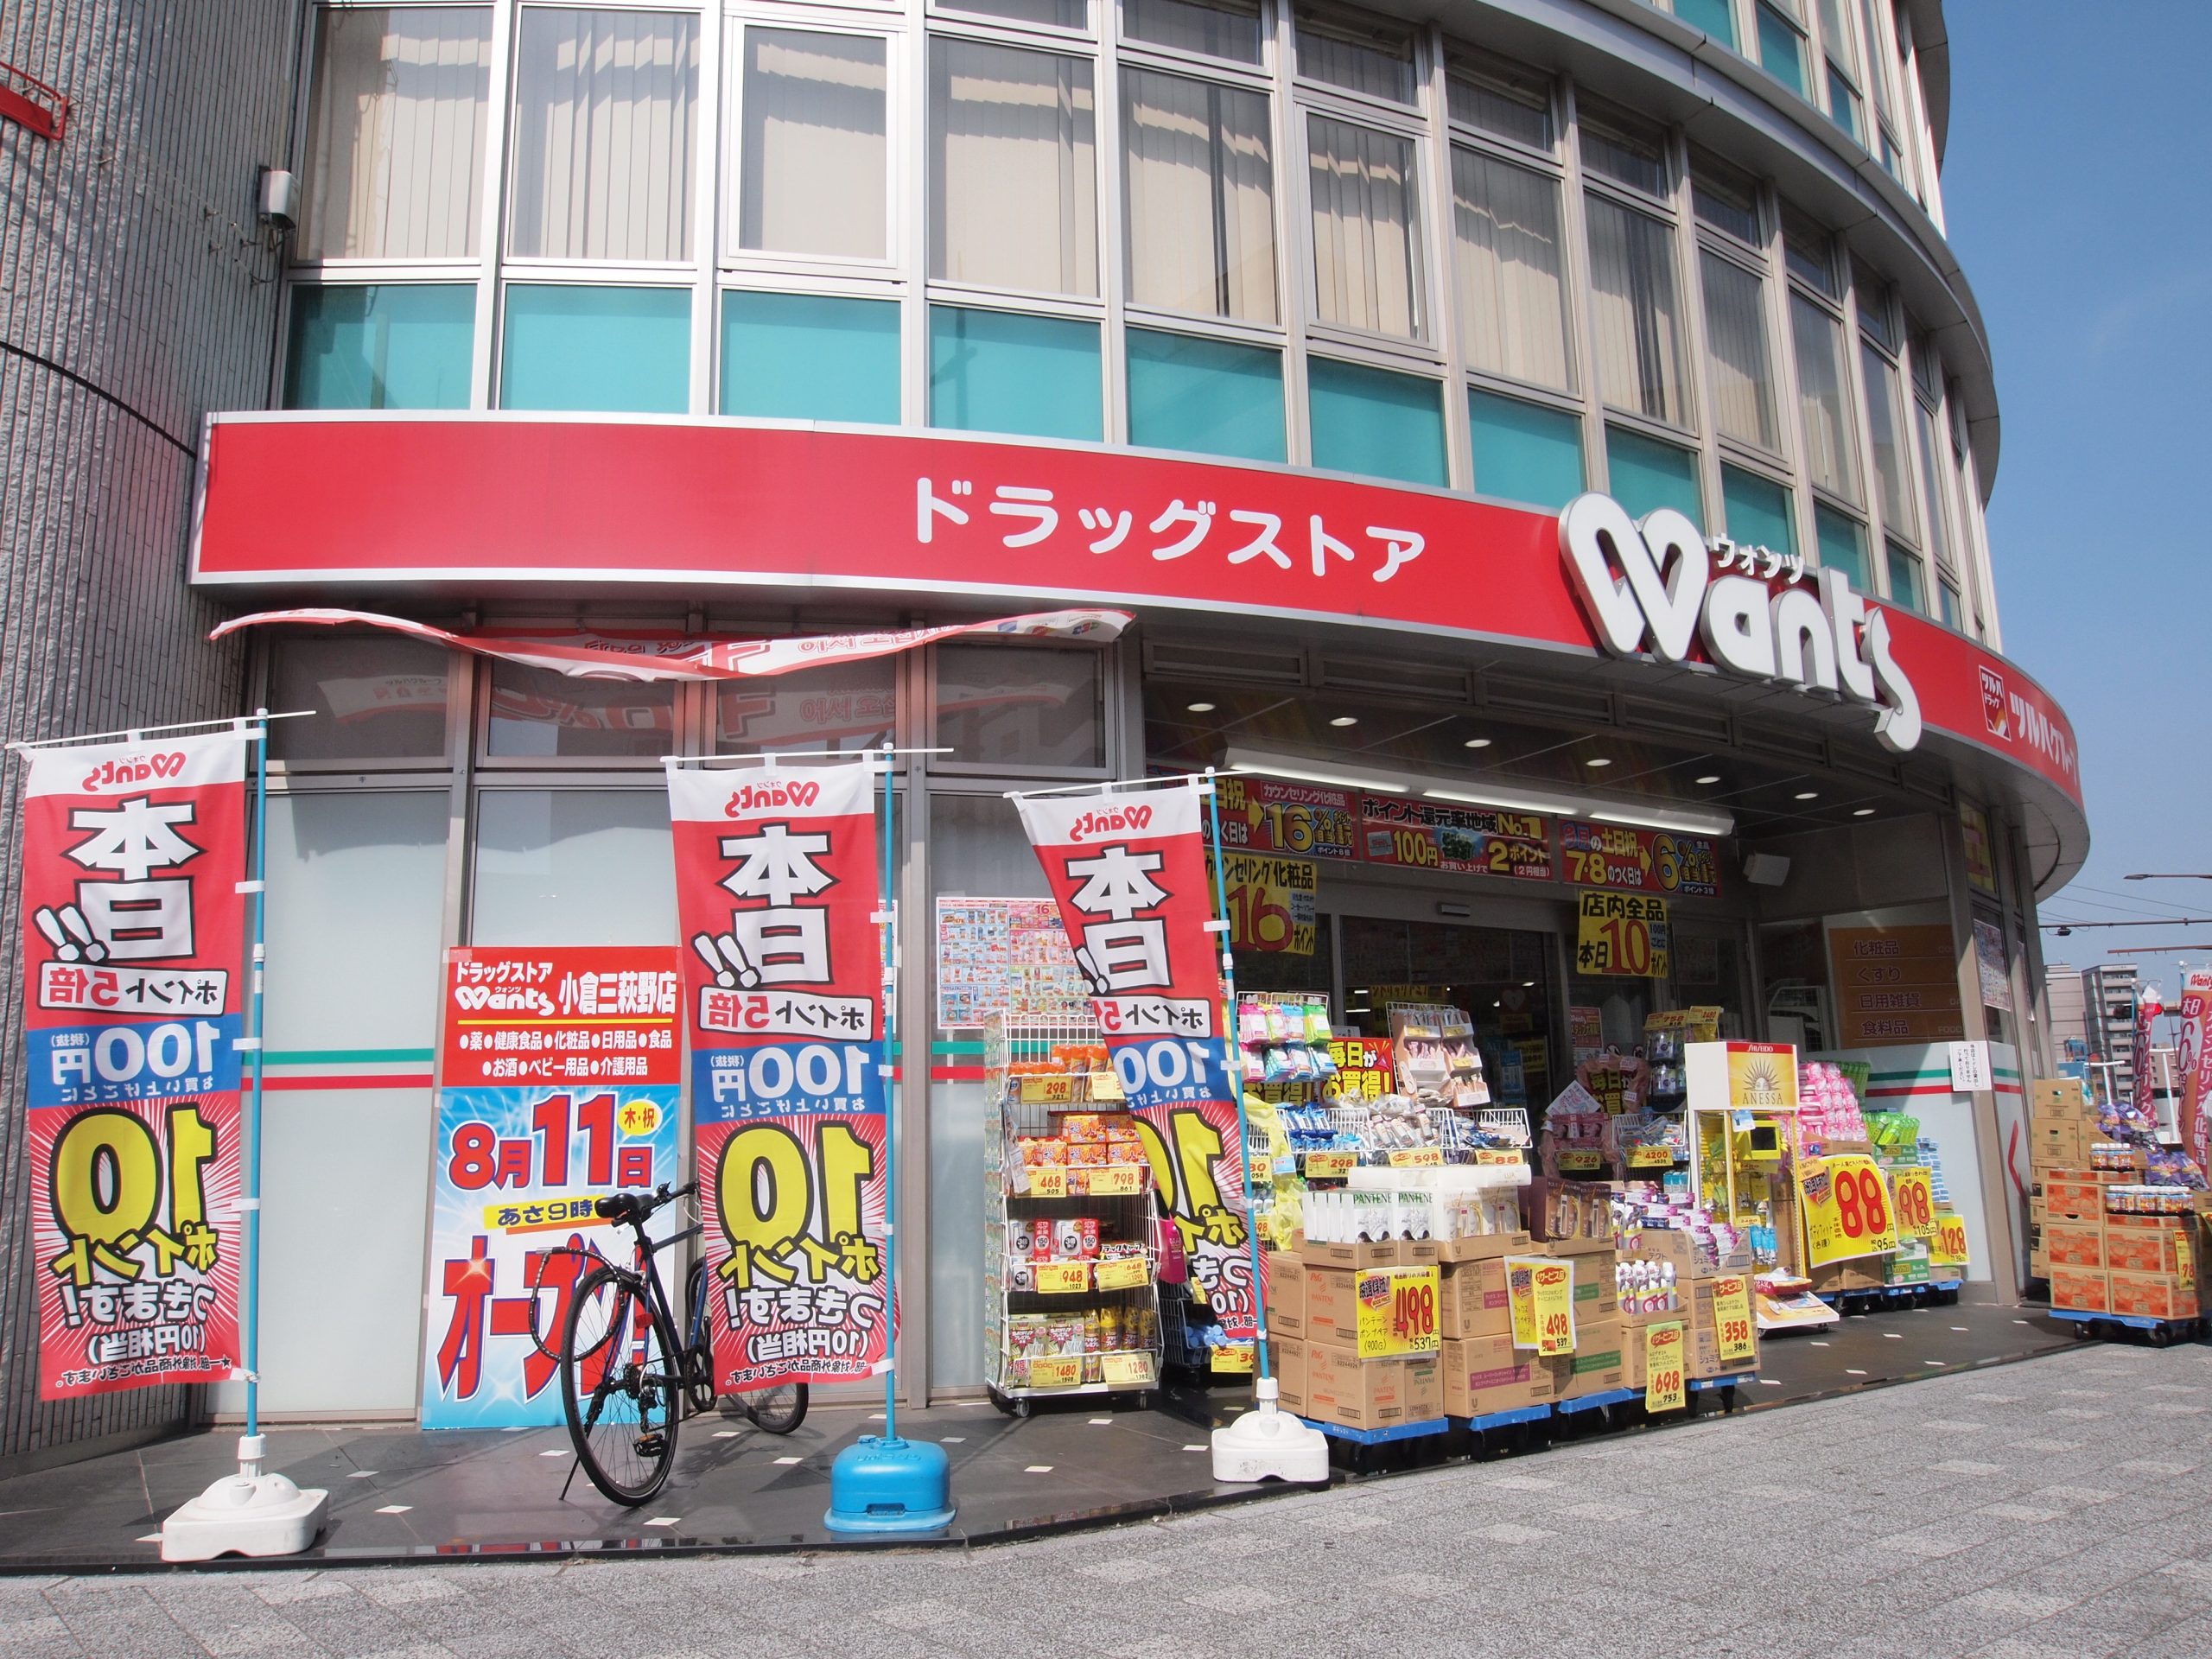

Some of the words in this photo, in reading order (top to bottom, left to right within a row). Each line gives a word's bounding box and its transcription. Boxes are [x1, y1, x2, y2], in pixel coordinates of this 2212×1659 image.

[917, 477, 1425, 582] ドラッグストア
[1709, 532, 1805, 585] ウォンツ
[1558, 491, 1922, 753] Wants
[1263, 785, 1345, 806] カウンセリング化粧品
[1202, 818, 1248, 844] のく日は
[1440, 861, 1489, 874] お買い上げで
[1582, 893, 1664, 921] 店内全品
[1579, 940, 1608, 969] 本日
[1599, 918, 1650, 975] 10
[1853, 940, 1899, 956] 化粧品
[456, 961, 553, 983] ドラッグストア
[1858, 966, 1901, 982] くすり
[454, 985, 555, 1016] Wants
[558, 971, 677, 1015] 小倉三萩野店
[1860, 992, 1921, 1008] 日用雑貨
[1862, 1020, 1909, 1034] 食料品
[1747, 1044, 1774, 1052] SHISEIDO
[1046, 1082, 1066, 1094] 298
[1743, 1092, 1783, 1105] ANESSA
[448, 1091, 652, 1191] 8月11日
[1330, 1159, 1353, 1168] 298
[1414, 1153, 1440, 1162] 598
[1495, 1155, 1518, 1164] 88
[1040, 1176, 1061, 1188] 468
[1113, 1173, 1135, 1185] 798
[1353, 1192, 1392, 1205] PANTENE
[1398, 1192, 1433, 1204] PANTENE
[1940, 1226, 1967, 1255] 128
[1062, 1270, 1083, 1283] 948
[1546, 1313, 1568, 1335] 498
[1725, 1320, 1748, 1342] 358
[1556, 1338, 1567, 1347] 537
[1056, 1364, 1077, 1377] 1480
[1128, 1361, 1148, 1374] 1280
[1656, 1370, 1680, 1394] 698
[1663, 1393, 1677, 1402] 753
